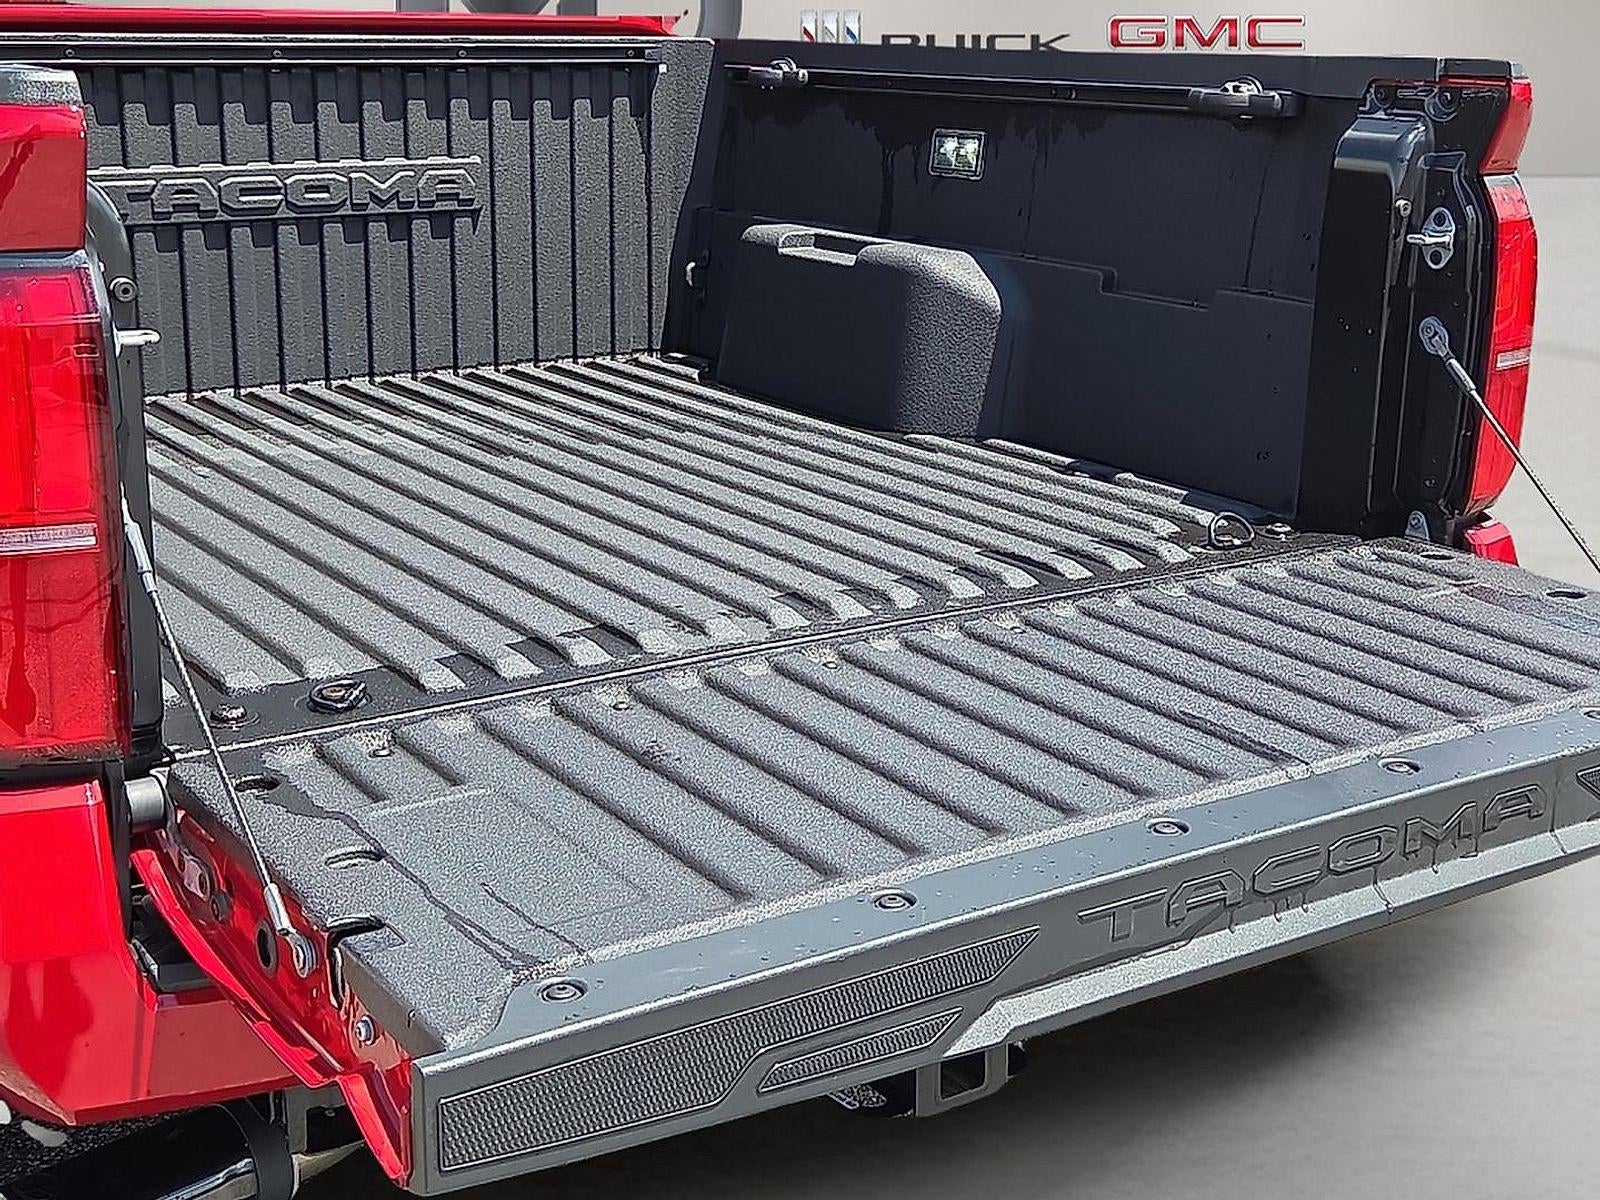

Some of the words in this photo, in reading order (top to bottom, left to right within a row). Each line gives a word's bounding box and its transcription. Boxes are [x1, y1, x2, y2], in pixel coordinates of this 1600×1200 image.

[1107, 15, 1306, 51] GMC
[95, 168, 476, 219] TACOMA
[1075, 784, 1548, 943] TACOMA
